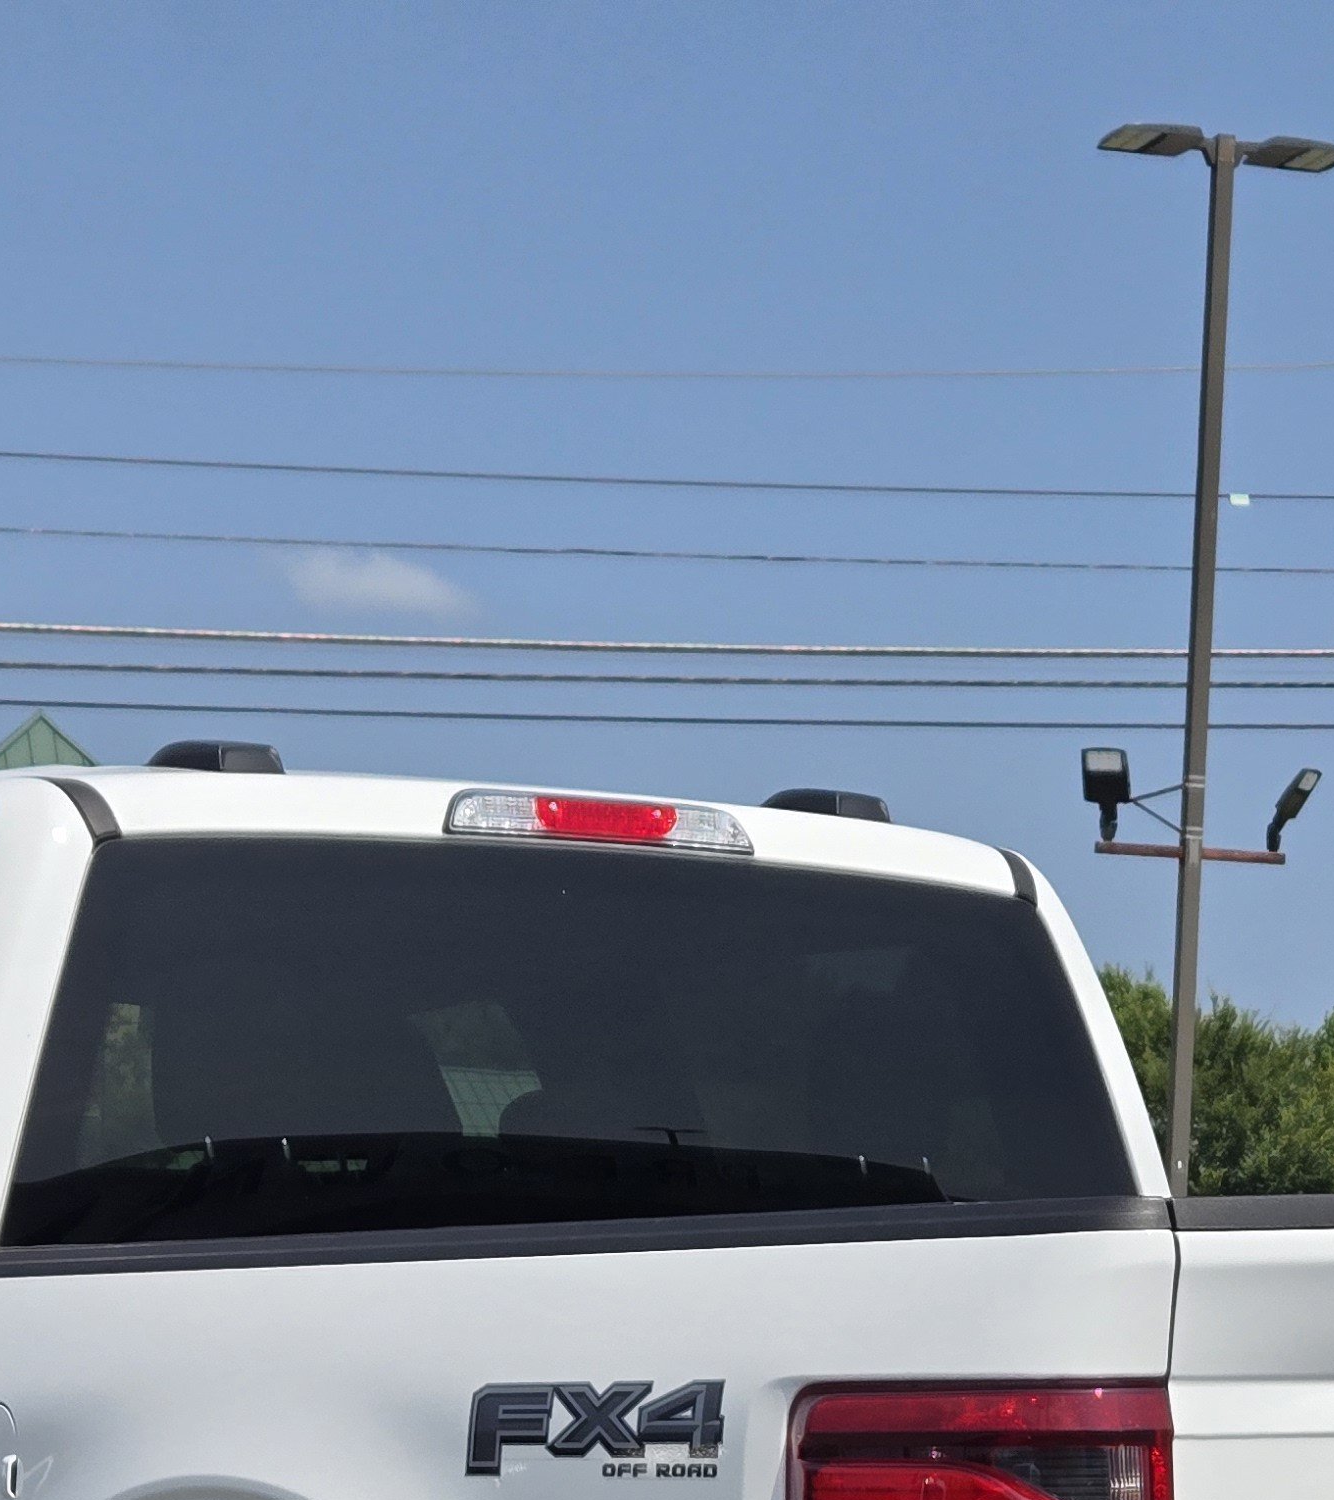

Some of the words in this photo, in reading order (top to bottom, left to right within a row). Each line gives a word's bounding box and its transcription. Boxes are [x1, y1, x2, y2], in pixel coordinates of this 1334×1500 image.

[465, 1380, 725, 1477] FX4
[602, 1463, 647, 1478] OFF
[655, 1463, 718, 1478] ROAD
